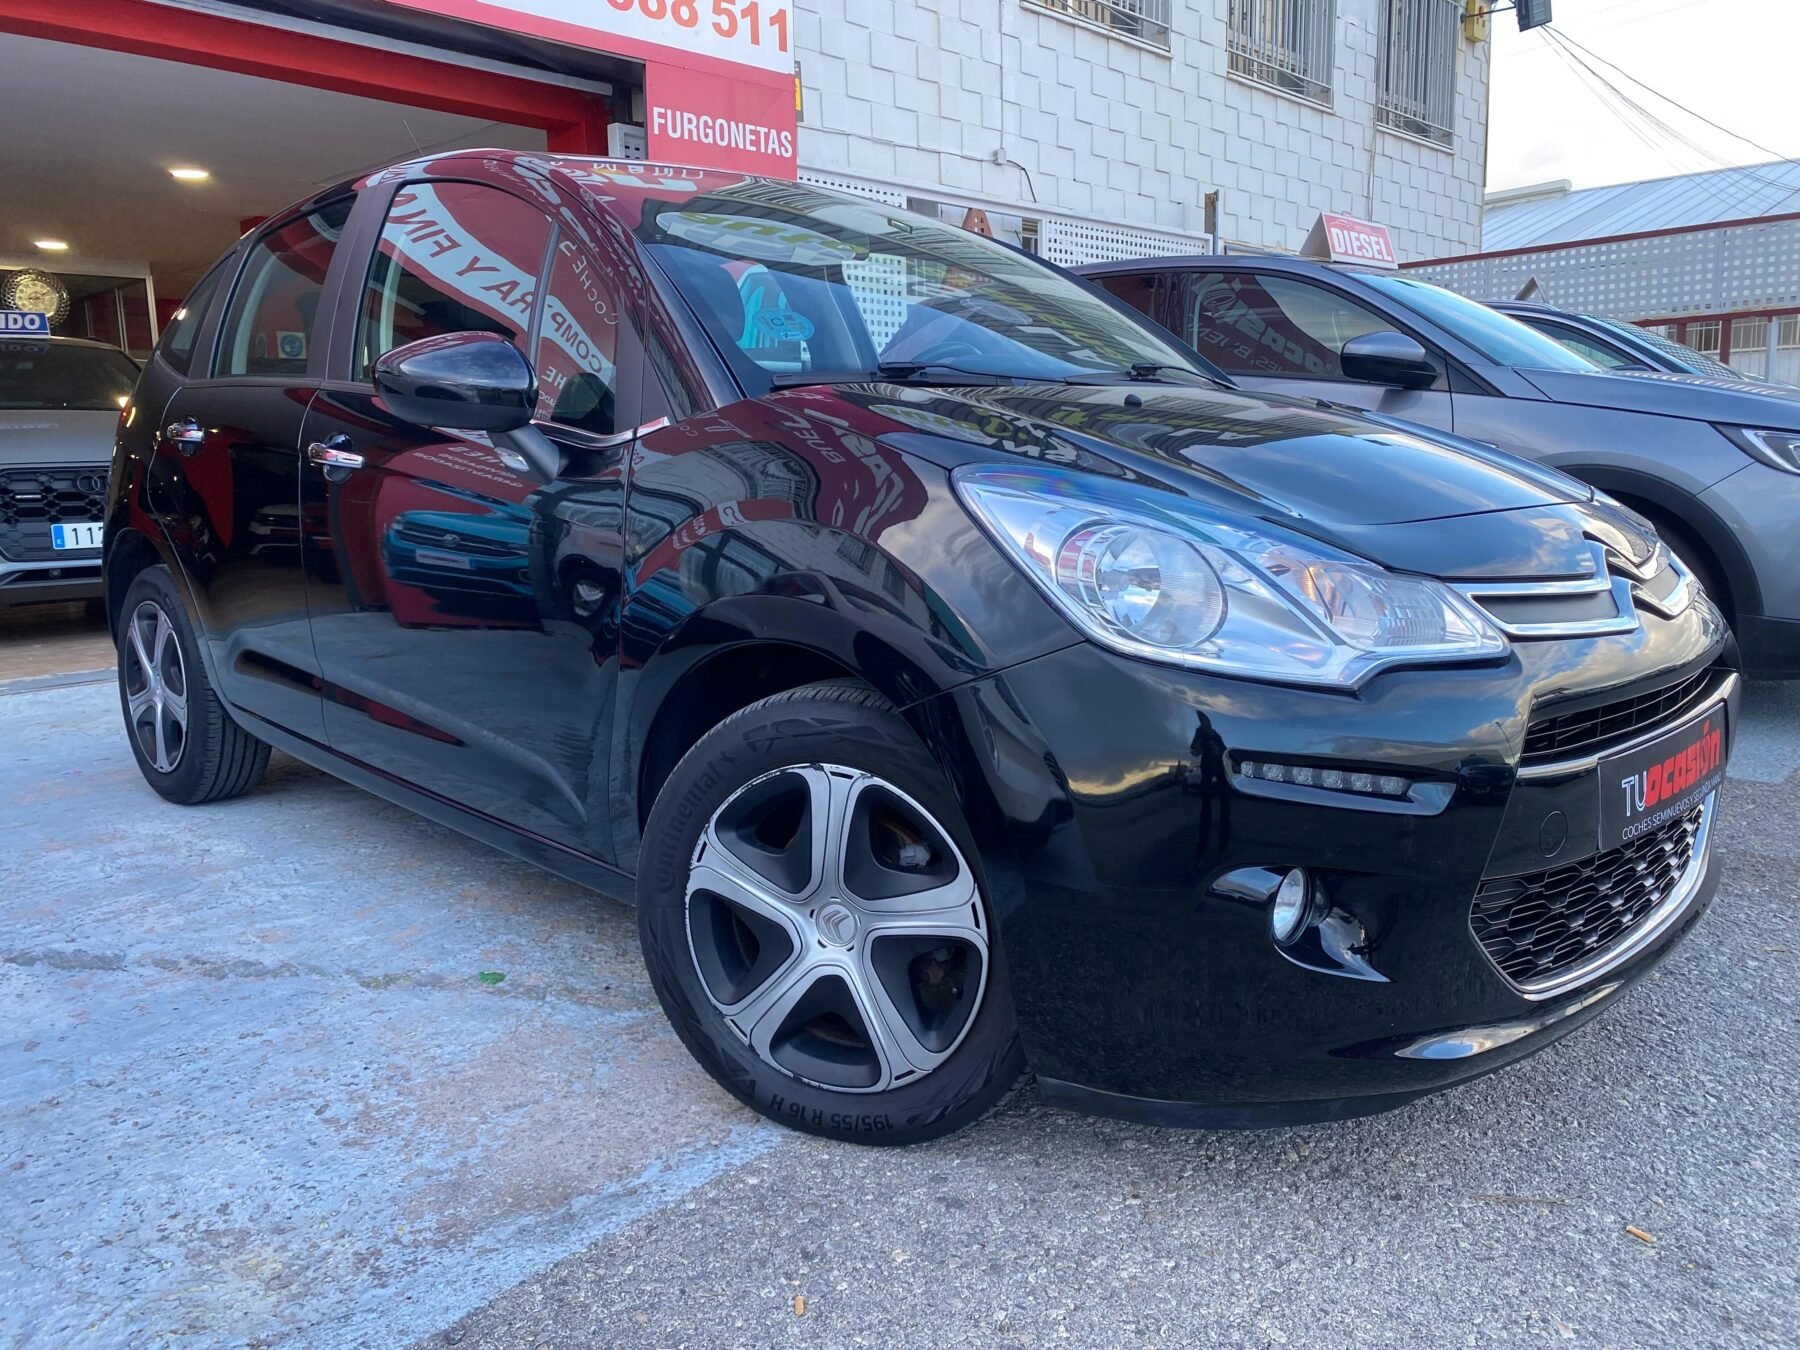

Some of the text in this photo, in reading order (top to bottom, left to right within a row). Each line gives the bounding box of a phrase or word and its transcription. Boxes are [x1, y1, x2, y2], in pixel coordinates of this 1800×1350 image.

[652, 106, 793, 158] FURGONETAS
[1330, 227, 1393, 261] DIESEL
[1622, 816, 1652, 840] COCHES
[1652, 800, 1690, 826] SEMINUEVOS
[769, 1093, 894, 1132] 195/55 R 16 H
